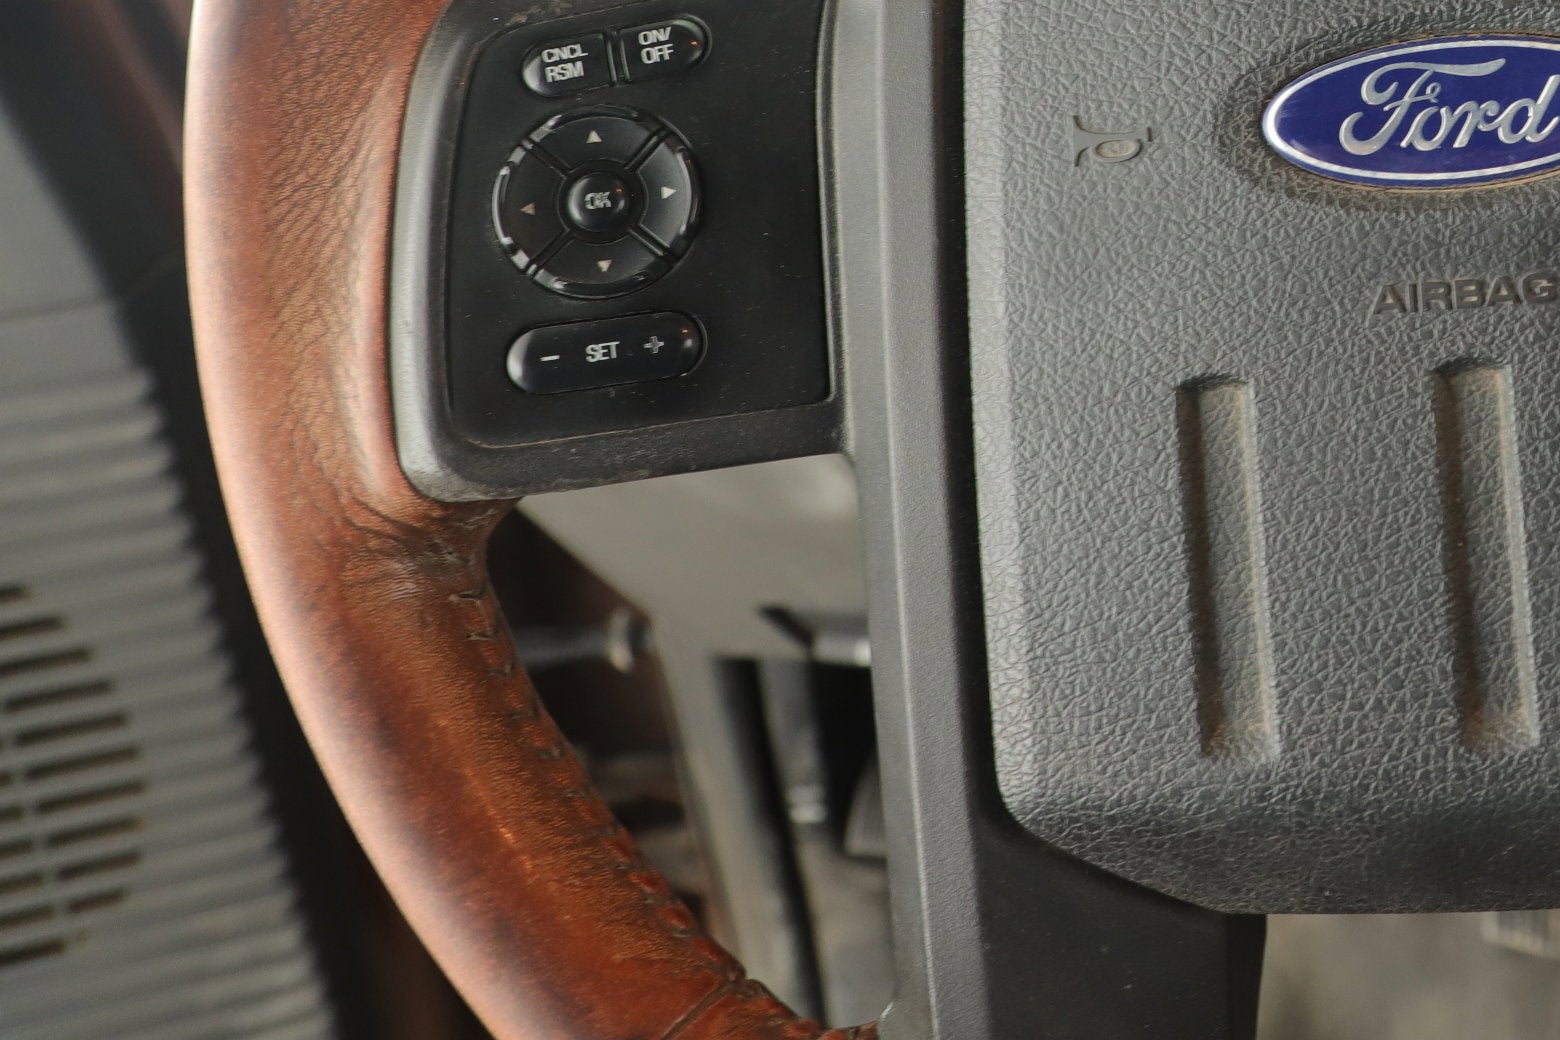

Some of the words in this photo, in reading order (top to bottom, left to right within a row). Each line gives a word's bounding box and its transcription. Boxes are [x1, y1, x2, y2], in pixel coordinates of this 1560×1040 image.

[541, 43, 589, 63] CNCL
[640, 43, 675, 65] OFF
[544, 60, 585, 83] RSM
[584, 191, 612, 210] OK
[1366, 271, 1560, 315] AIRBAG
[585, 340, 620, 363] SET
